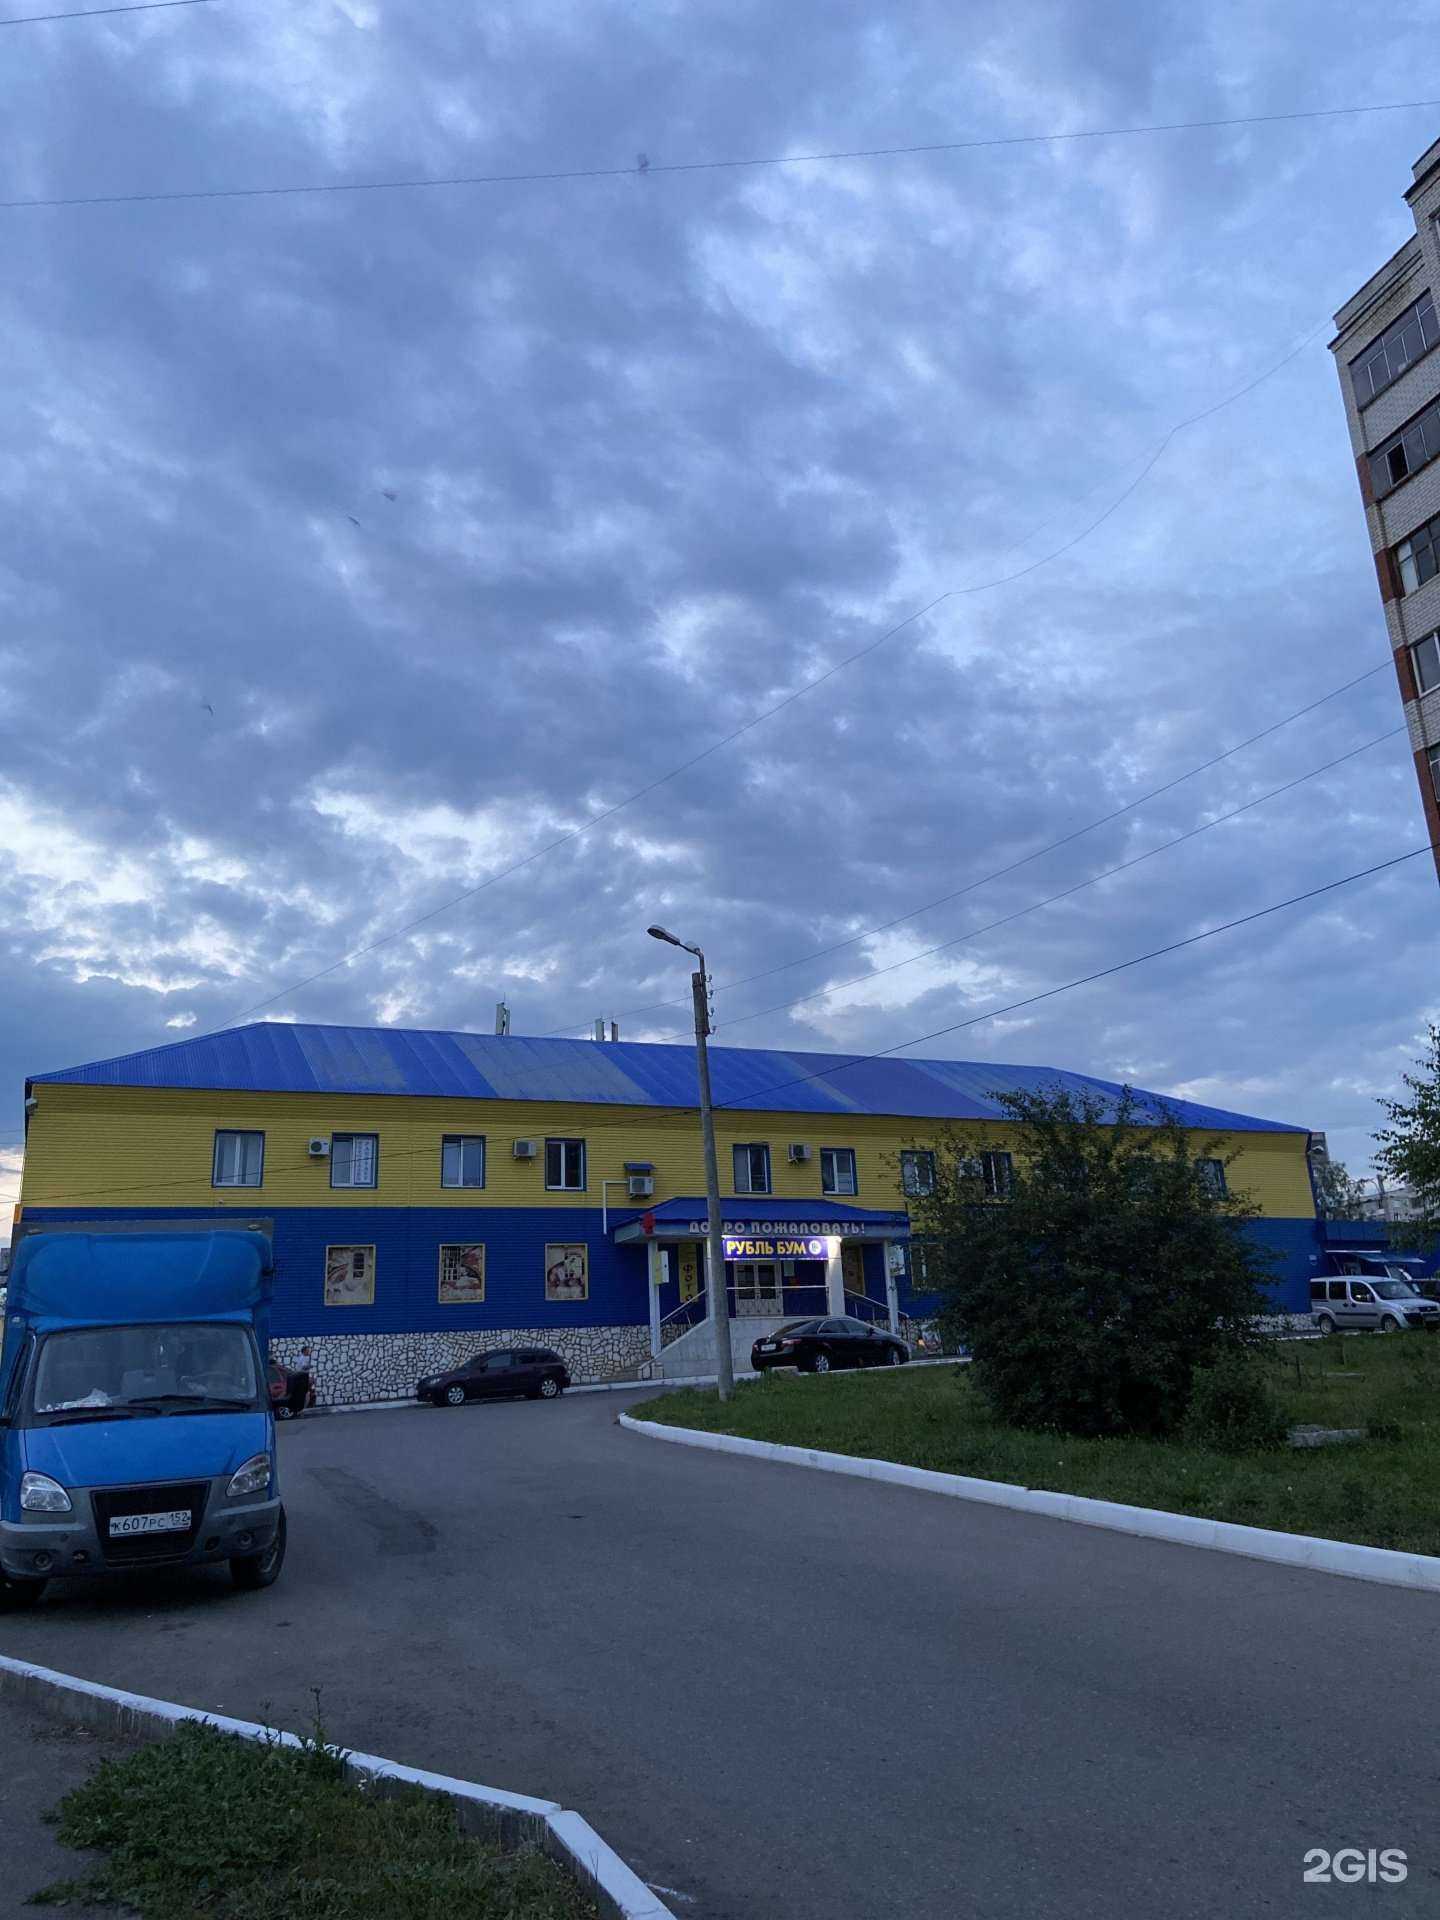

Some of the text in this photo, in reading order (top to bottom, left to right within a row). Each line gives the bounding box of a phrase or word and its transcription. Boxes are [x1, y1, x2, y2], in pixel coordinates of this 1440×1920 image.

[689, 1221, 866, 1234] ДОРО ПОЖАЛОВАТЬ!
[726, 1240, 774, 1255] РУБЛЬ
[777, 1241, 806, 1255] БУМ
[170, 1512, 188, 1522] 152
